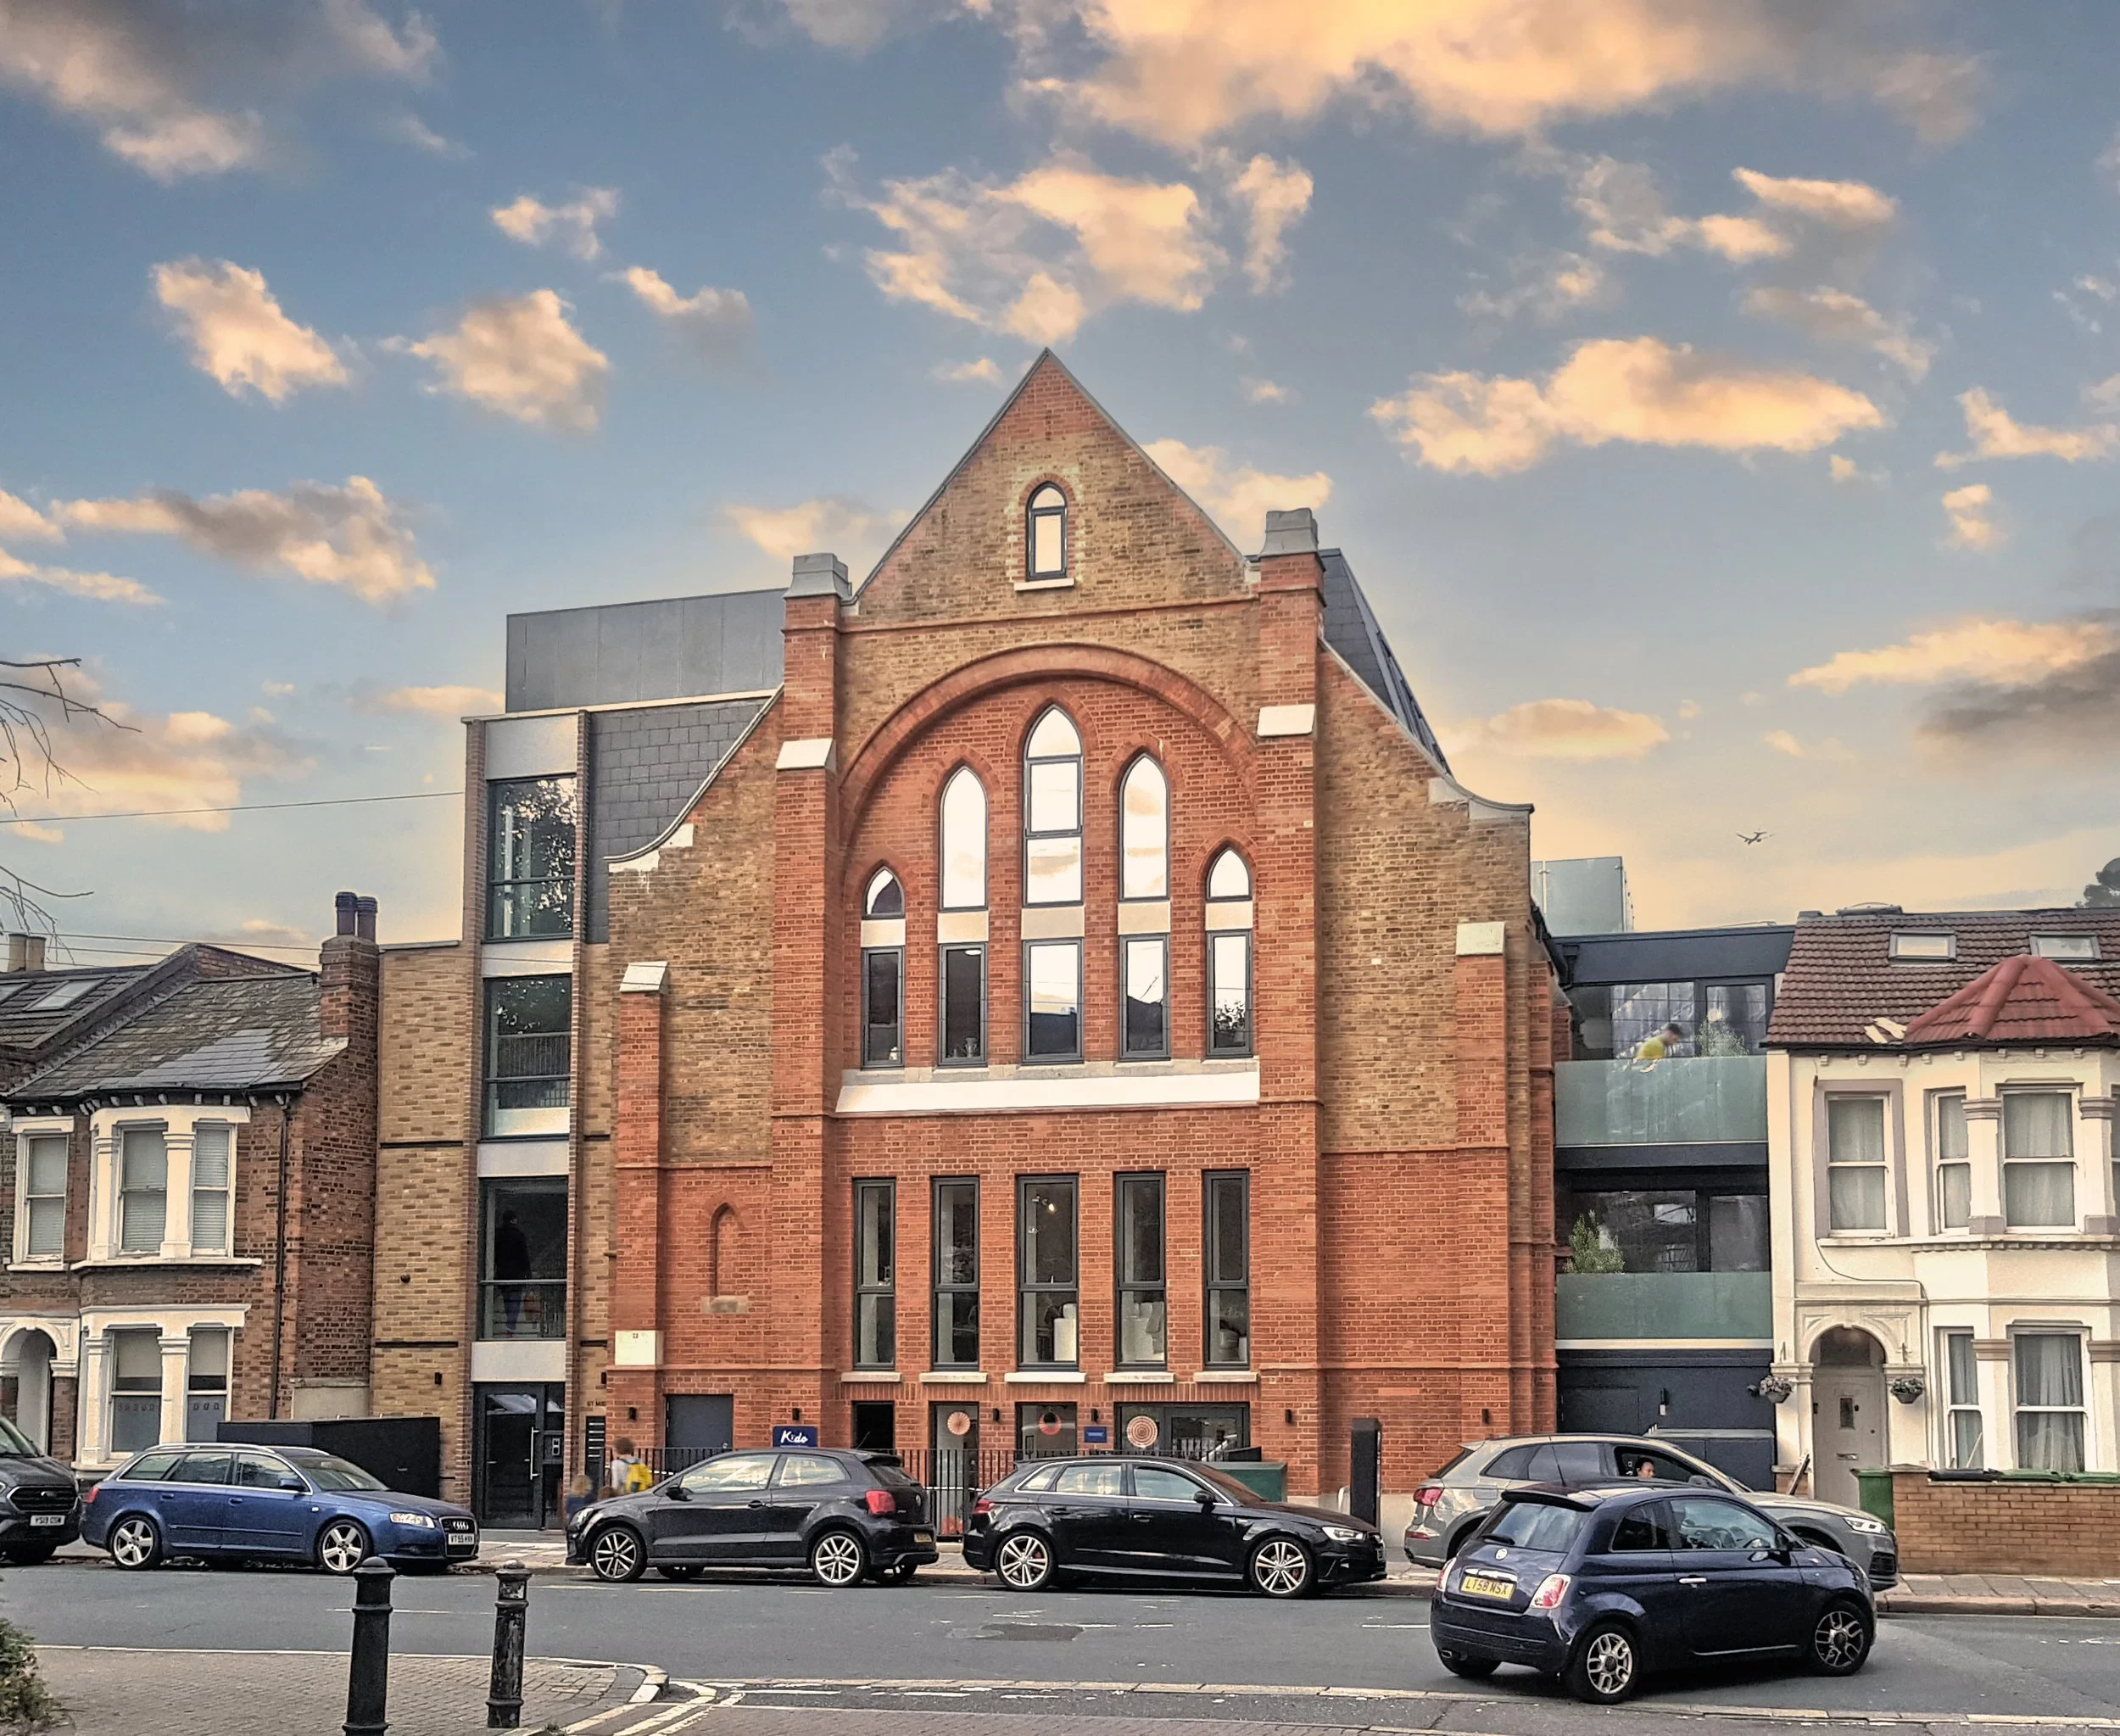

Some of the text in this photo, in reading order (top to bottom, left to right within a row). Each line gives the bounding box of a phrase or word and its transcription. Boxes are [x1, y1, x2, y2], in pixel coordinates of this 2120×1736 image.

[780, 1429, 809, 1443] Kido
[1465, 1577, 1509, 1595] LT58 NSX
